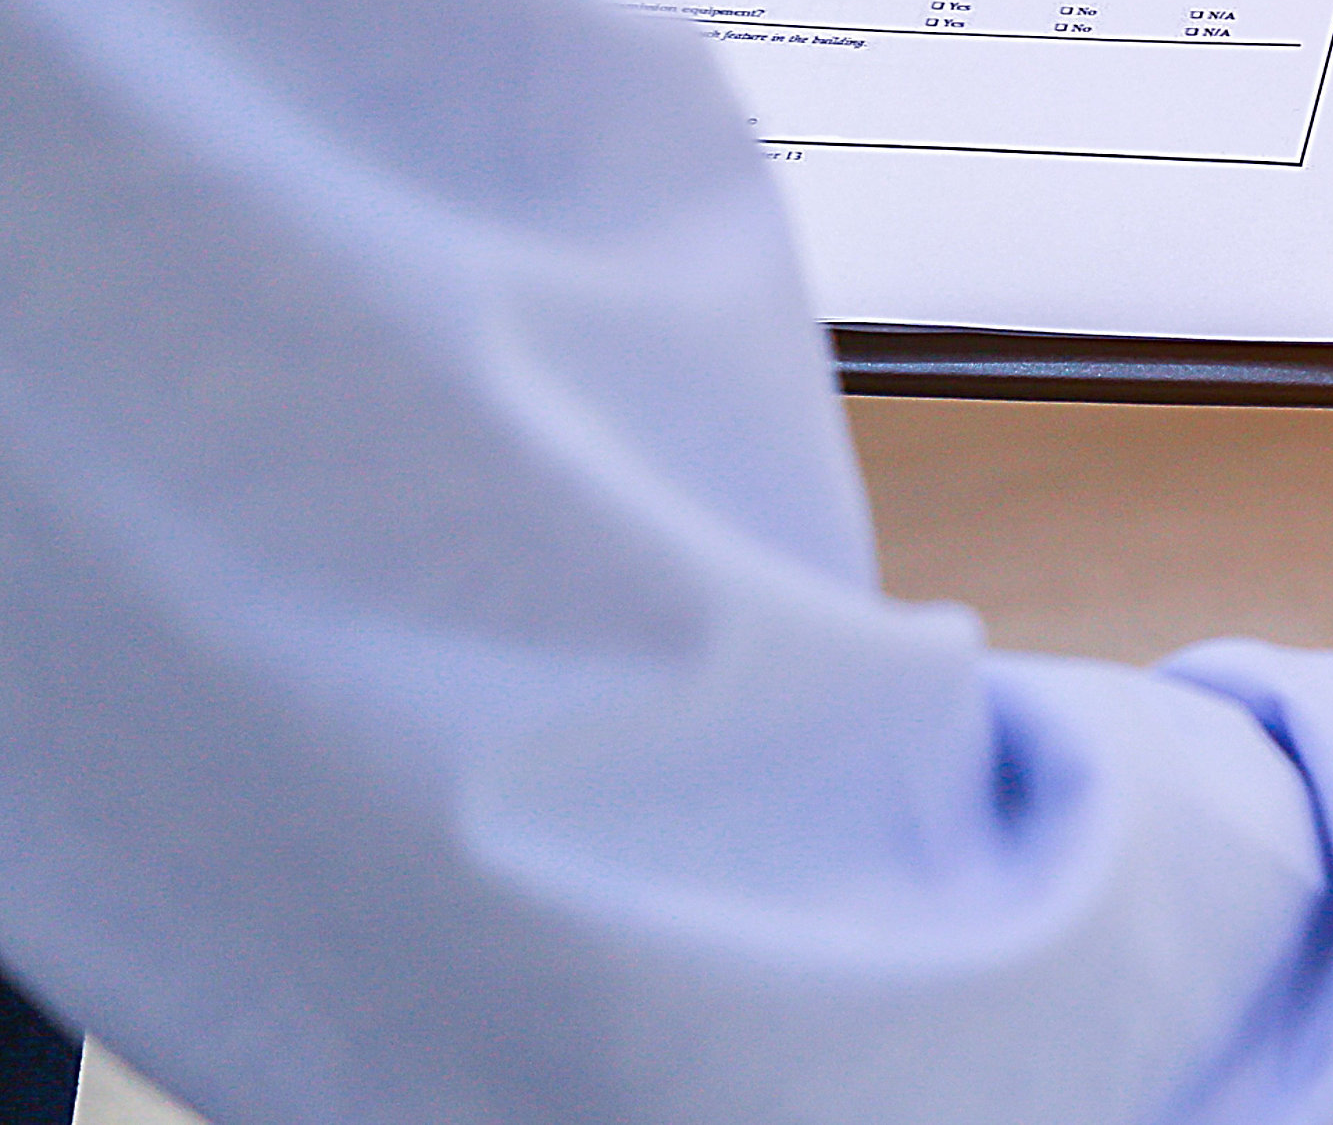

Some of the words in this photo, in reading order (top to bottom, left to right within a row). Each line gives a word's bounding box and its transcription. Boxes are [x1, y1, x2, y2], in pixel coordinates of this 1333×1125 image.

[681, 5, 765, 17] equipment?
[949, 2, 971, 11] Yes
[1077, 7, 1097, 16] No
[1207, 10, 1235, 21] N/A
[942, 19, 965, 28] Yes
[1072, 24, 1092, 33] No
[1202, 27, 1231, 37] N/A
[721, 31, 768, 41] feature
[771, 34, 785, 42] in
[789, 35, 808, 43] the
[812, 36, 867, 48] building.
[786, 152, 802, 160] 13
